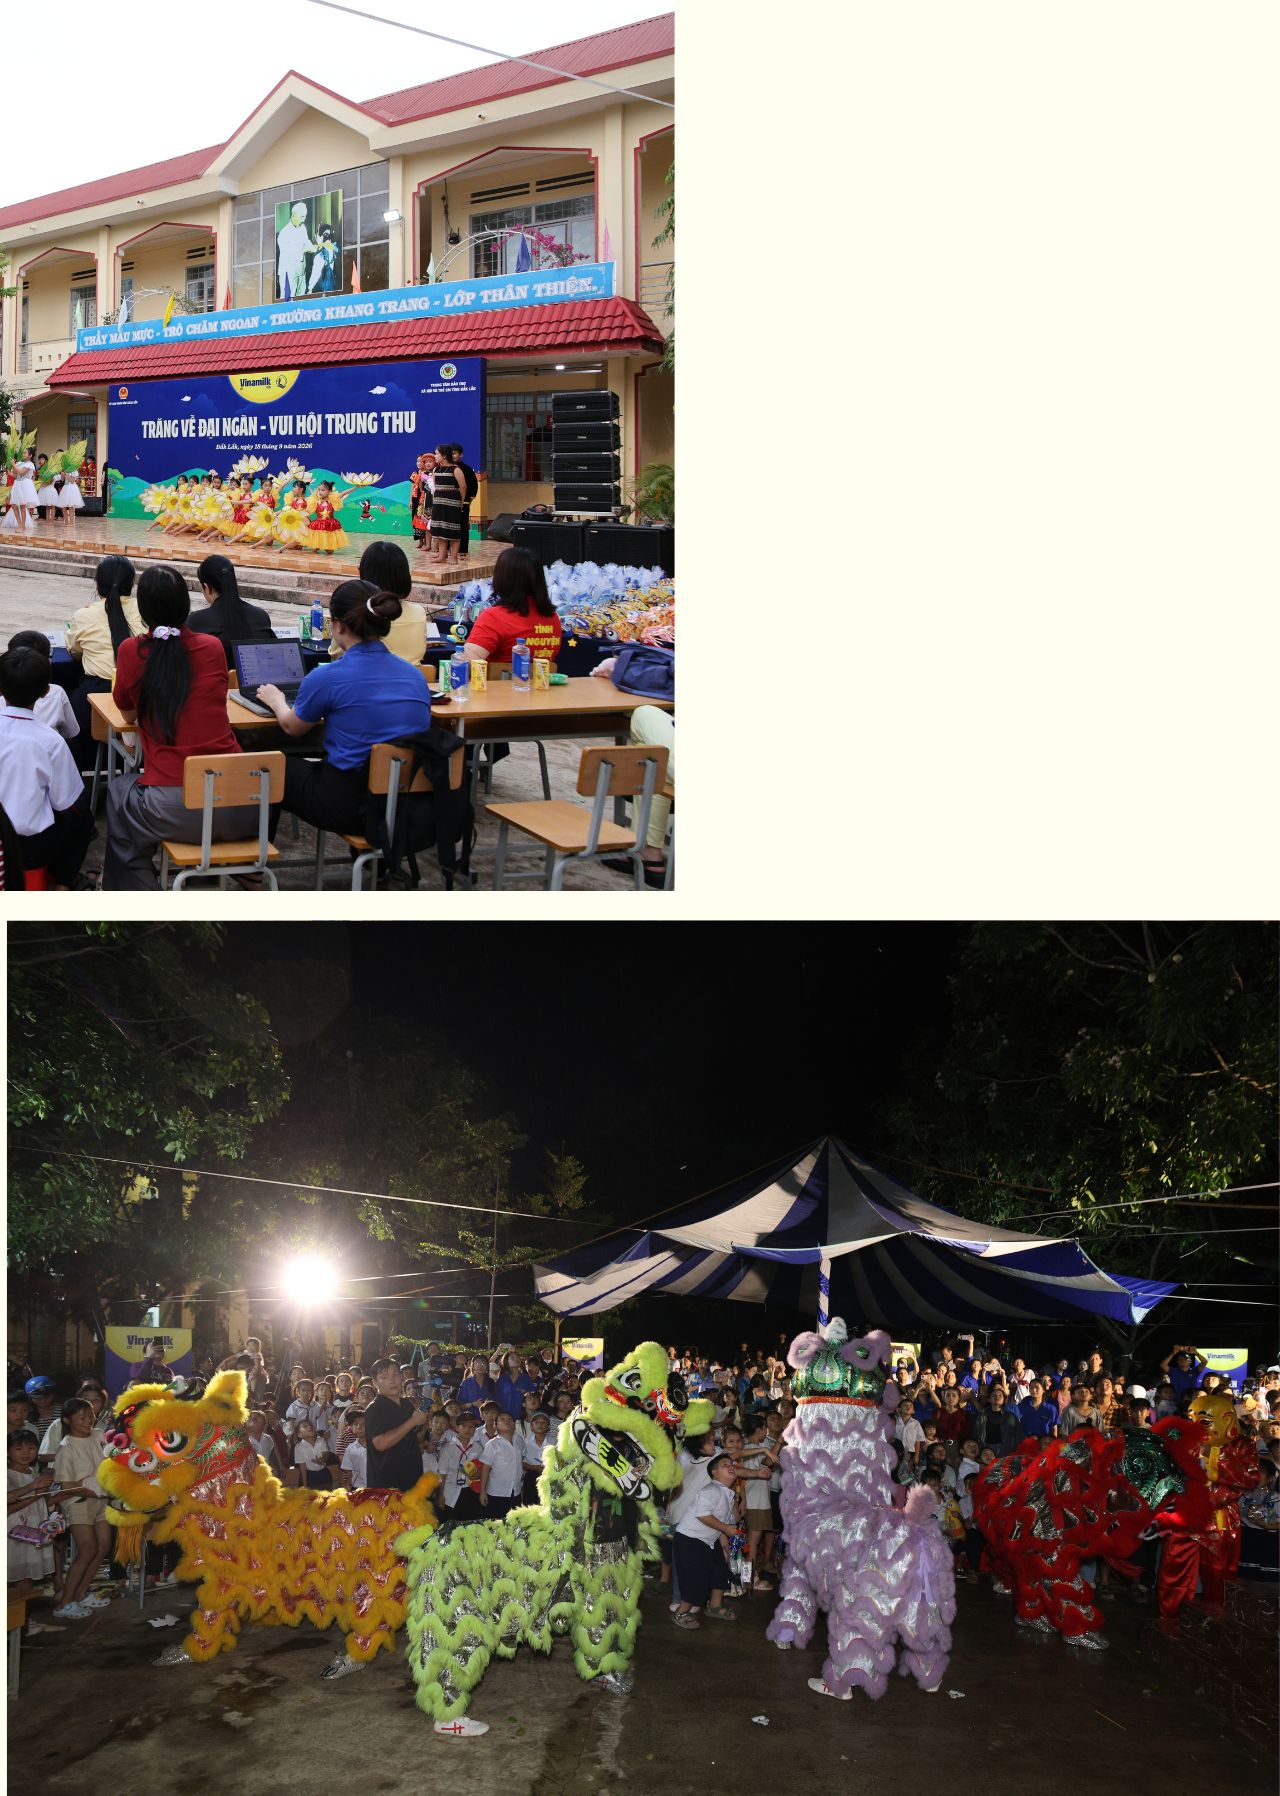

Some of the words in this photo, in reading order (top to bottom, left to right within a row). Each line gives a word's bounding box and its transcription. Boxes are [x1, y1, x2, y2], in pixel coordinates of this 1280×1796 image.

[221, 316, 260, 332] NGOAN
[325, 303, 375, 320] KHANG
[378, 297, 430, 314] TRANG
[479, 283, 529, 304] THÂN
[240, 377, 271, 387] Vinamilk
[141, 418, 179, 439] TRĂNG
[181, 414, 196, 438] VỀ
[198, 417, 220, 440] ĐẠI
[222, 414, 258, 437] NGÀN
[269, 415, 293, 436] VUI
[296, 411, 321, 438] HỘI
[325, 411, 378, 435] TRUNG
[380, 410, 416, 434] THU
[127, 1335, 174, 1345] Vinalk
